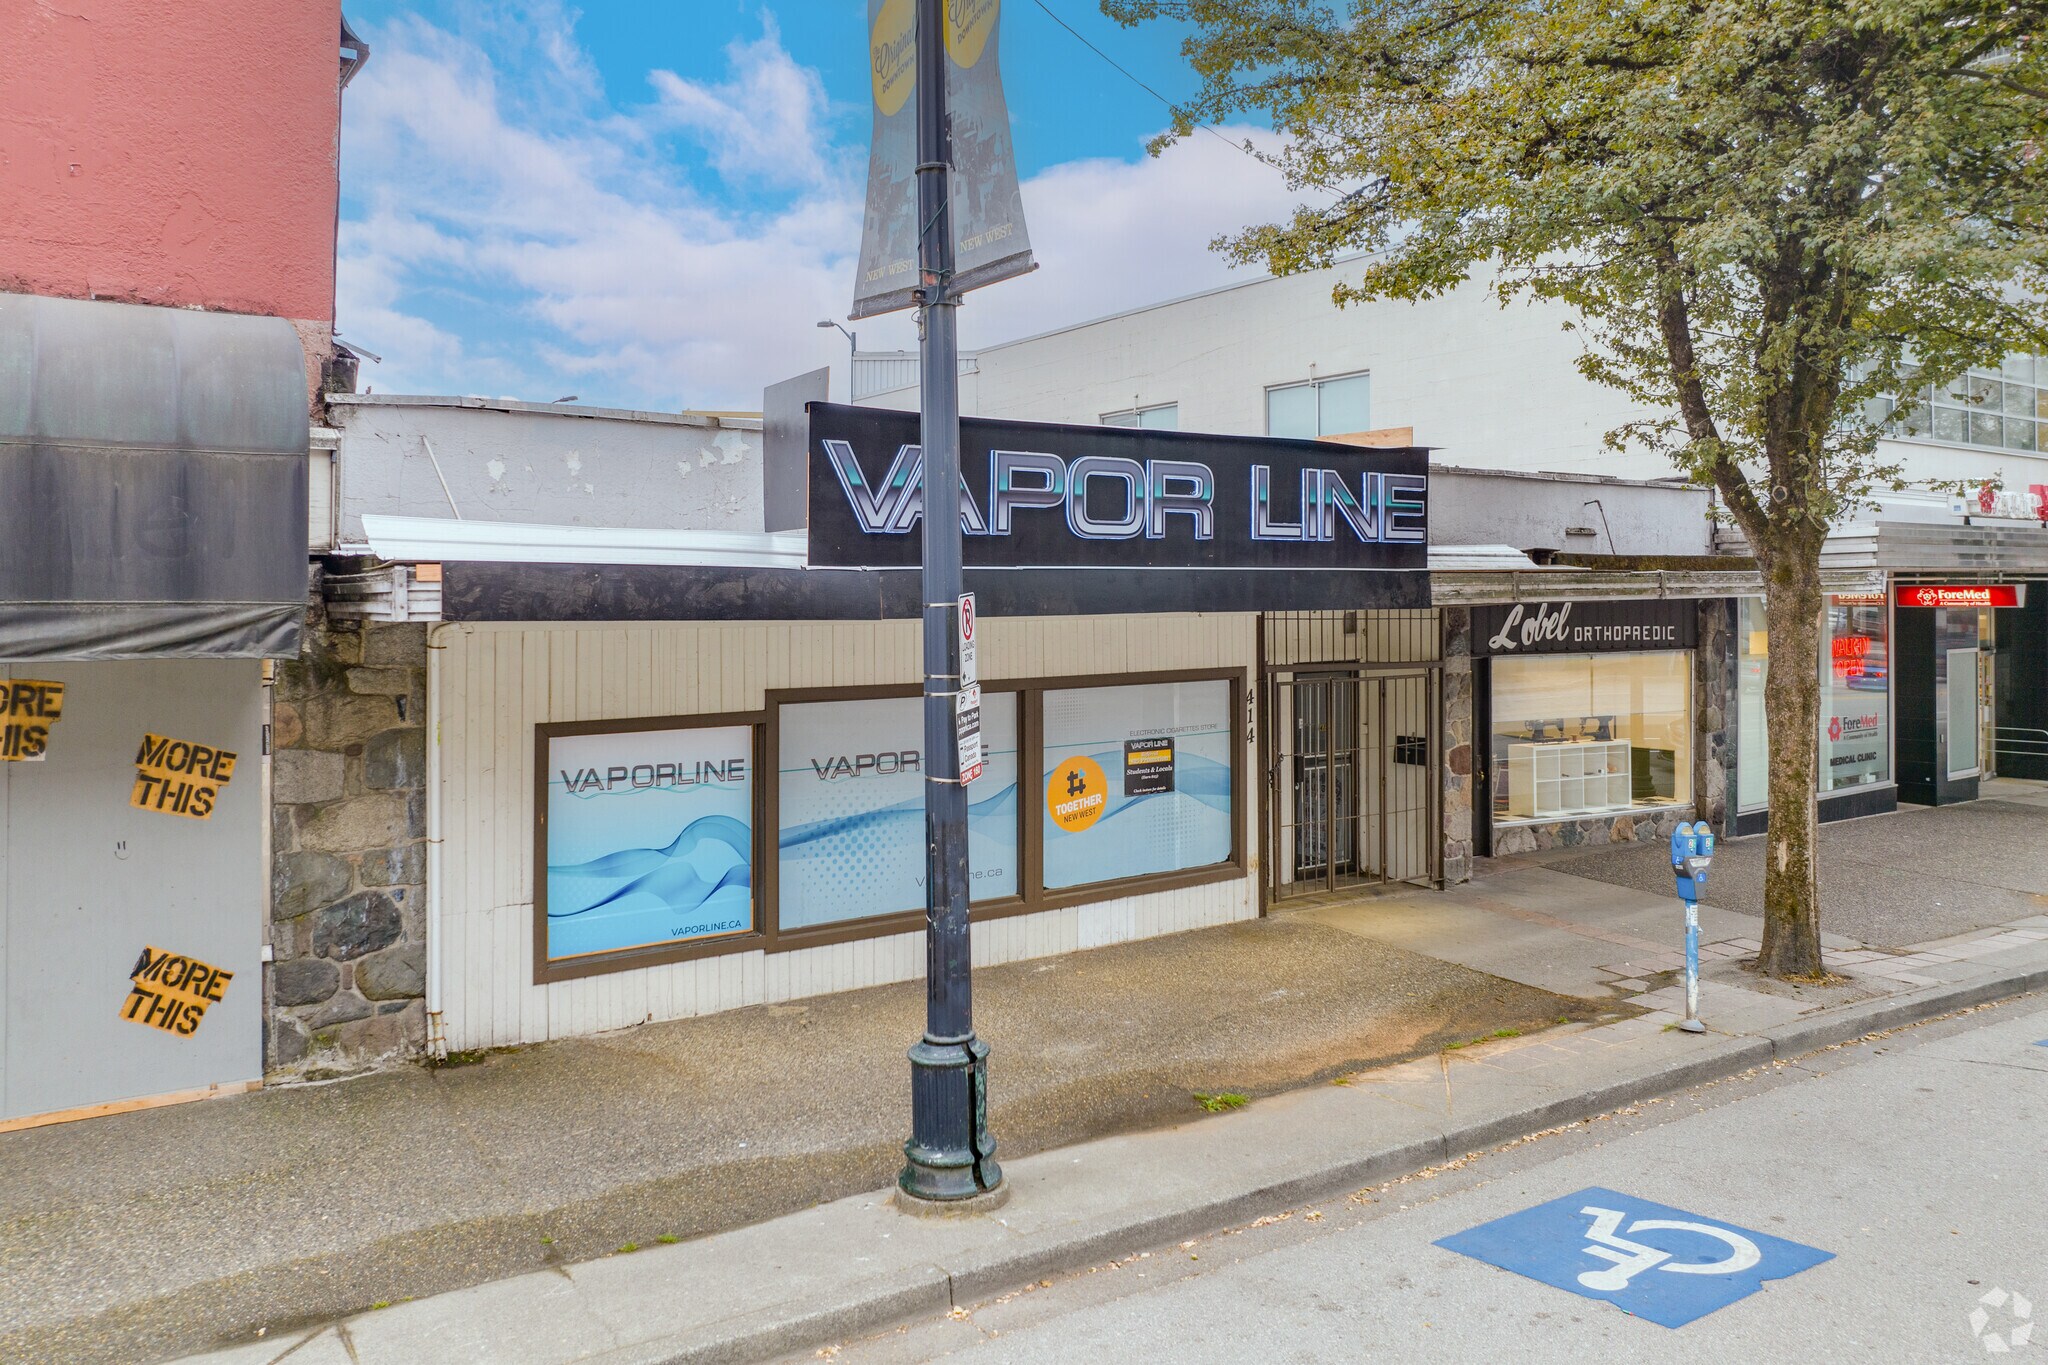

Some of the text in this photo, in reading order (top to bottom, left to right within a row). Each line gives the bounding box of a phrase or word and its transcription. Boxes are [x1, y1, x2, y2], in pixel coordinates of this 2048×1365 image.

[957, 1, 993, 44] DOWNTOWN
[882, 54, 915, 94] DOWNTOWN
[959, 222, 1013, 254] NEW WEST
[865, 258, 914, 283] NEW WEST
[1250, 463, 1427, 544] LINE
[1937, 588, 1990, 600] ForeMed
[1488, 602, 1675, 650] Lobel ORTHOPAEDIC
[1835, 658, 1864, 678] OPEN
[1129, 723, 1218, 737] ELECTRONIC CIGARETTES STORE
[1247, 689, 1255, 744] 414
[1843, 712, 1878, 731] ForeMed
[136, 735, 237, 782] MORE
[1131, 741, 1153, 750] VAPOR
[1830, 752, 1877, 767] MEDICAL CLINIC
[561, 758, 745, 793] VAPORLINE
[961, 768, 973, 783] ZONE
[139, 774, 215, 817] THIS
[1055, 793, 1103, 816] TOGETHER
[1063, 807, 1097, 824] NEW WEST
[671, 920, 742, 937] VAPORLINE.CA
[129, 948, 234, 1002] MORE
[128, 987, 204, 1035] THIS
